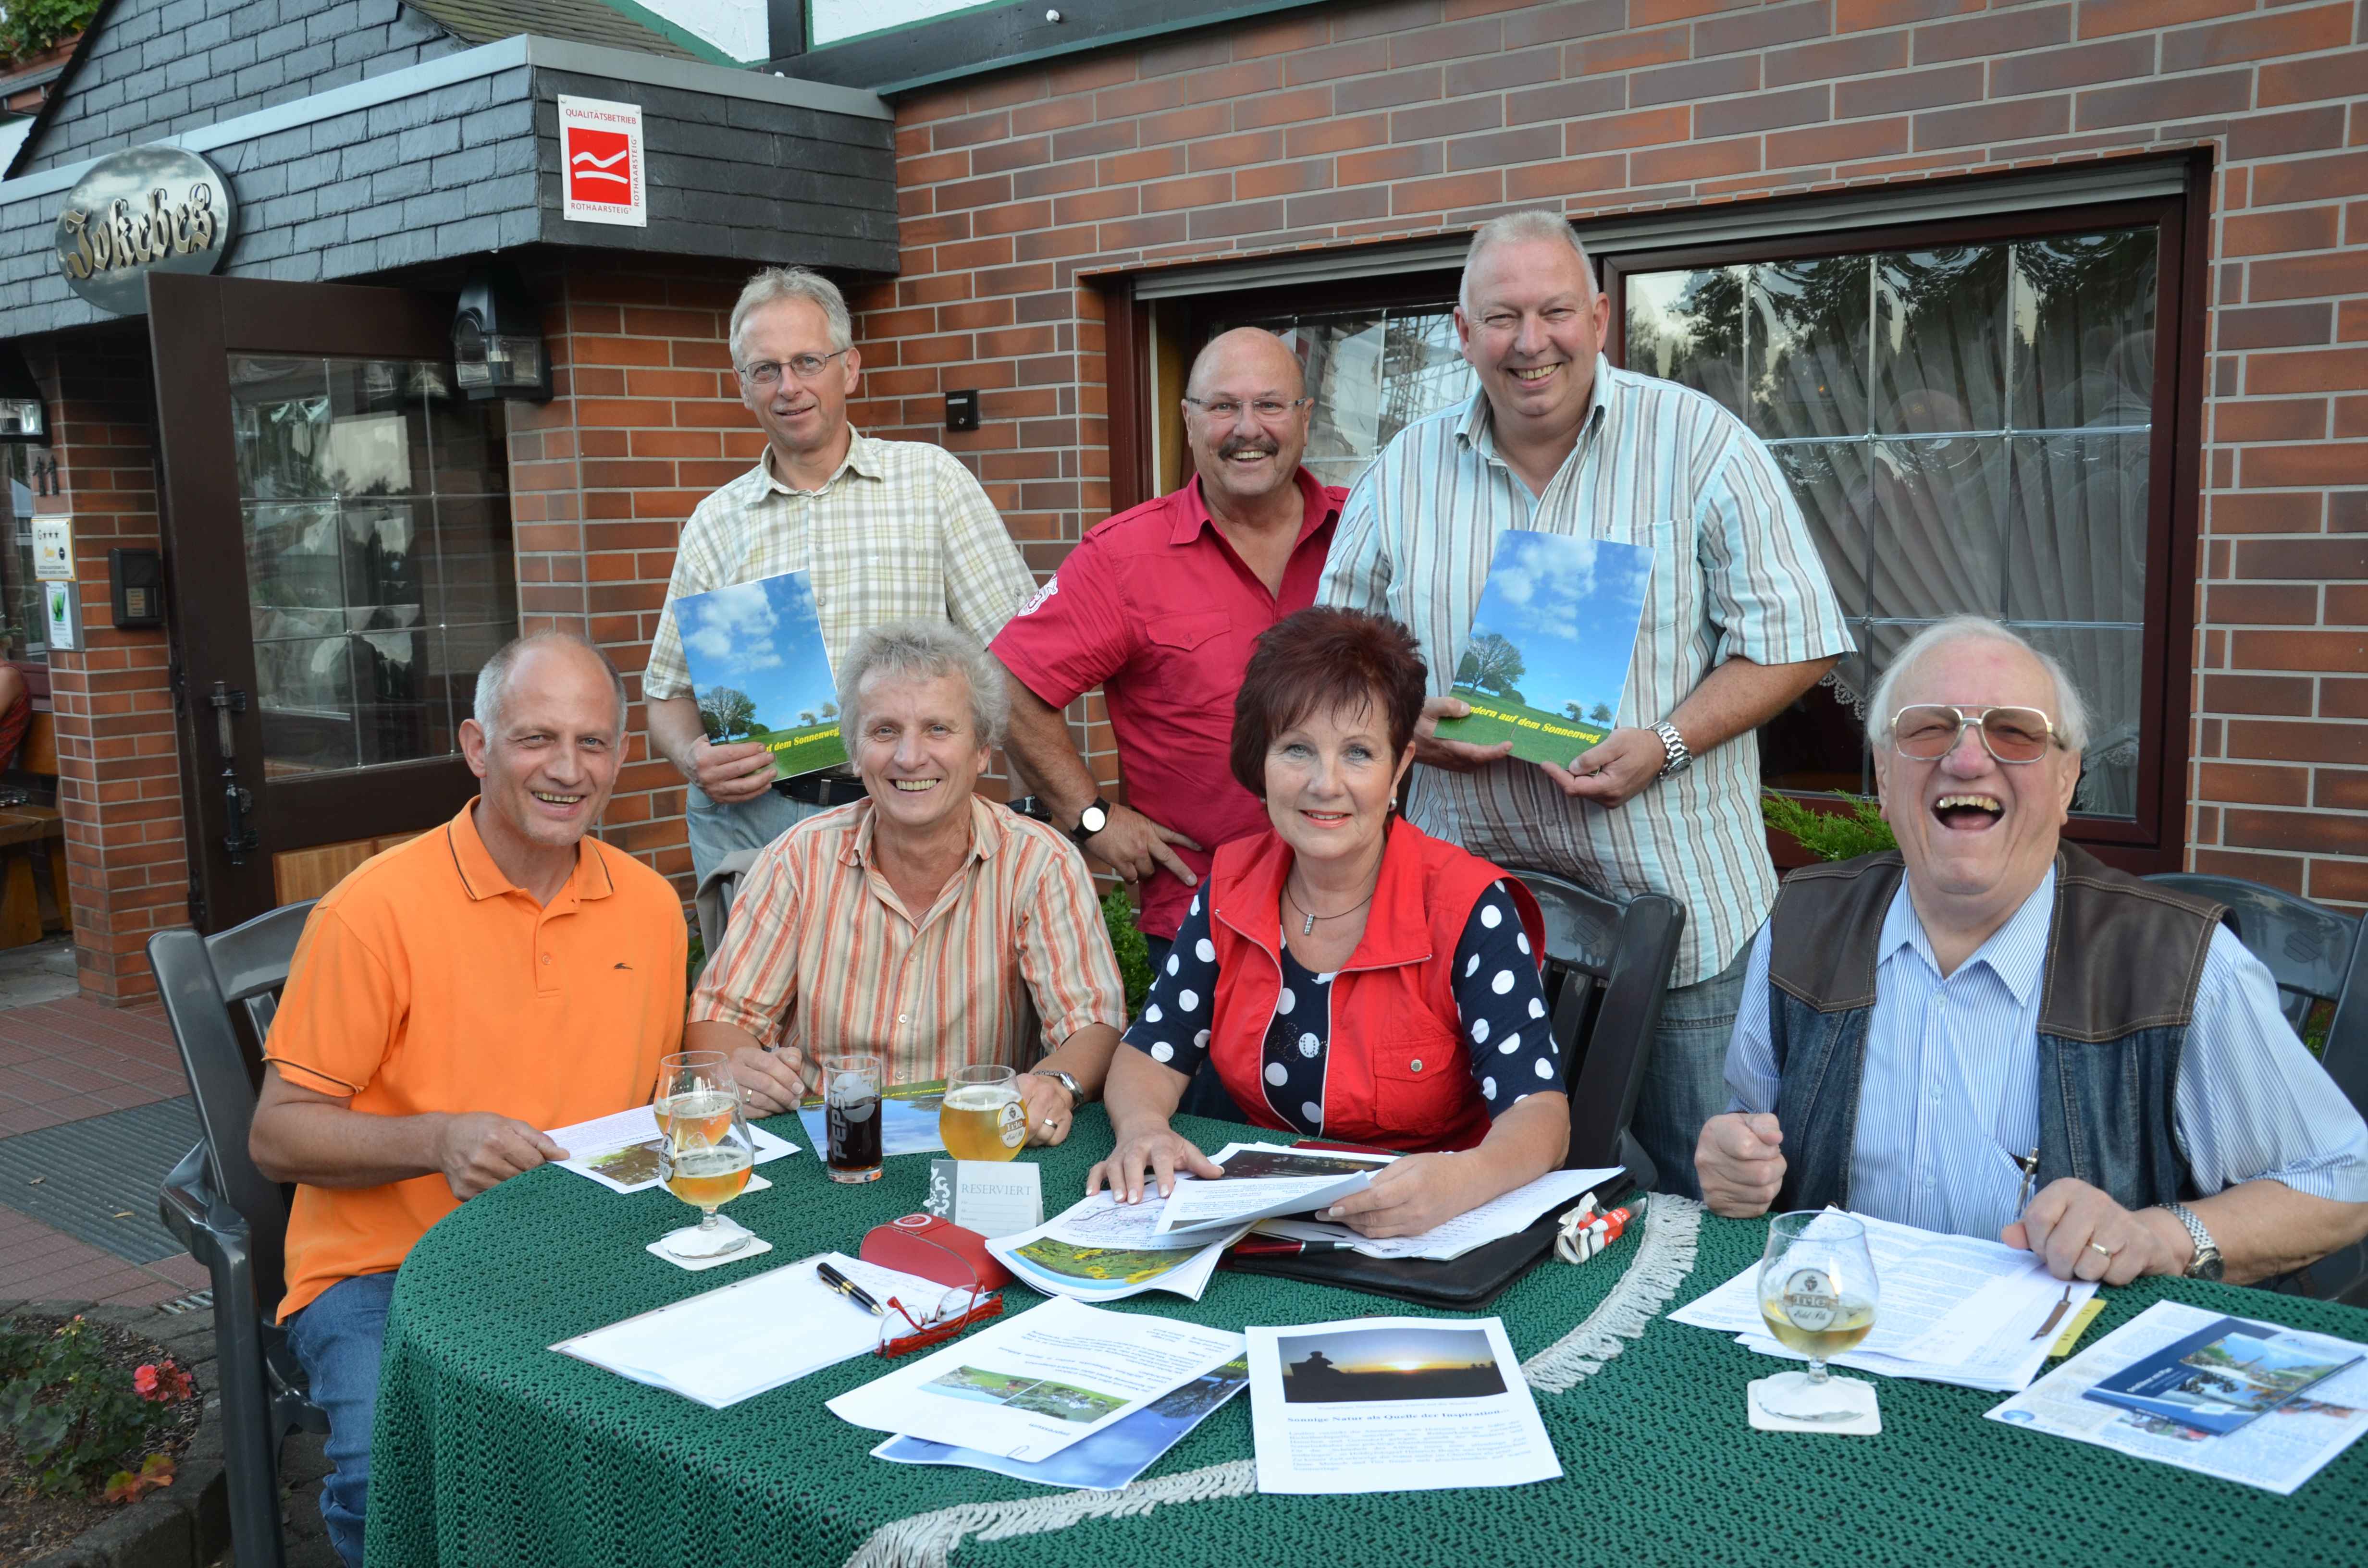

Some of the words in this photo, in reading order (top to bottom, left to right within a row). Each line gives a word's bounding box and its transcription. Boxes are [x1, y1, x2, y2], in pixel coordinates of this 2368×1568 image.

[566, 109, 637, 124] QUALITÄTSBETRIEB
[631, 139, 641, 207] ROTHAARSTEIG
[571, 203, 629, 214] ROTHAARSTEIG
[33, 455, 60, 497] 11
[1499, 712, 1518, 723] auf
[1517, 717, 1540, 730] dem
[1542, 723, 1601, 744] Sonnenweg
[775, 740, 792, 751] dem
[794, 726, 840, 747] Sonnenweg
[830, 1085, 848, 1160] PEPSI
[1007, 1121, 1023, 1130] Irle
[961, 1183, 1034, 1196] RESERVIERT
[1795, 1296, 1826, 1307] Irle
